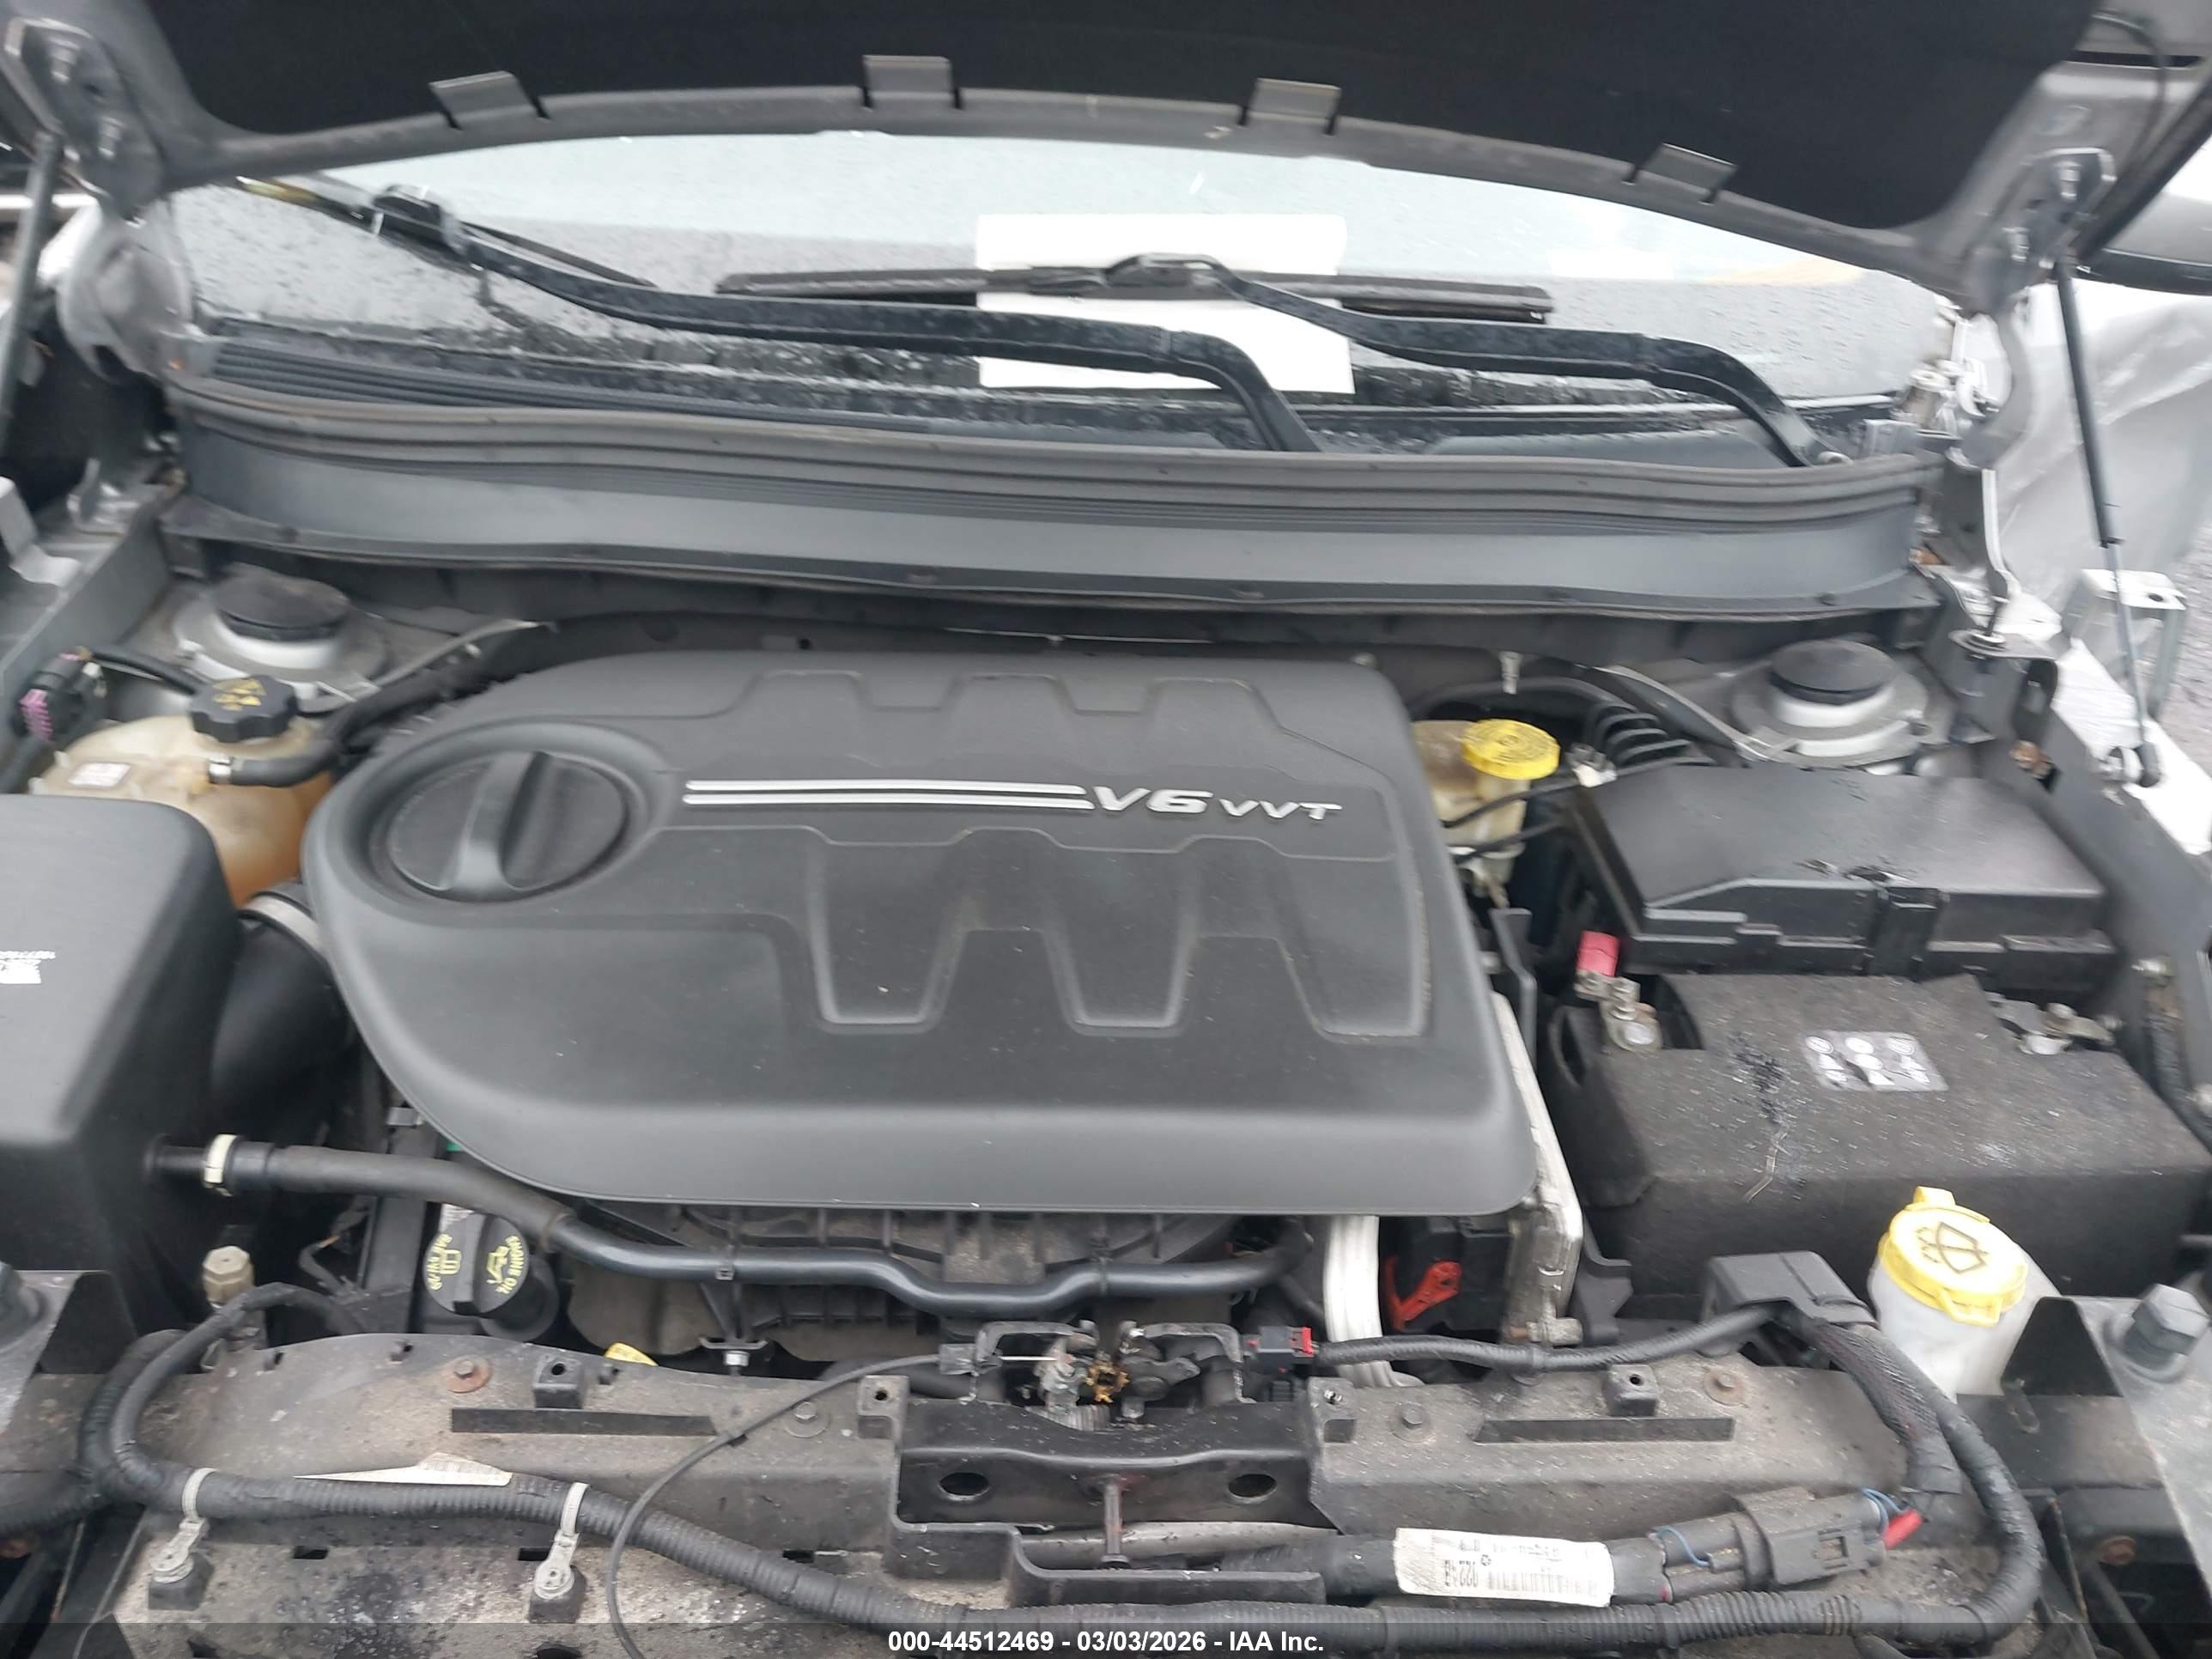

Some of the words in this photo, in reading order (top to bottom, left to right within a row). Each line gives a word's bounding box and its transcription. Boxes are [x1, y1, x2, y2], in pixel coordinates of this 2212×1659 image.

[1091, 785, 1214, 814] V6
[1218, 798, 1343, 821] VVT
[504, 1235, 525, 1277] ENGINE
[495, 1277, 518, 1295] OIL
